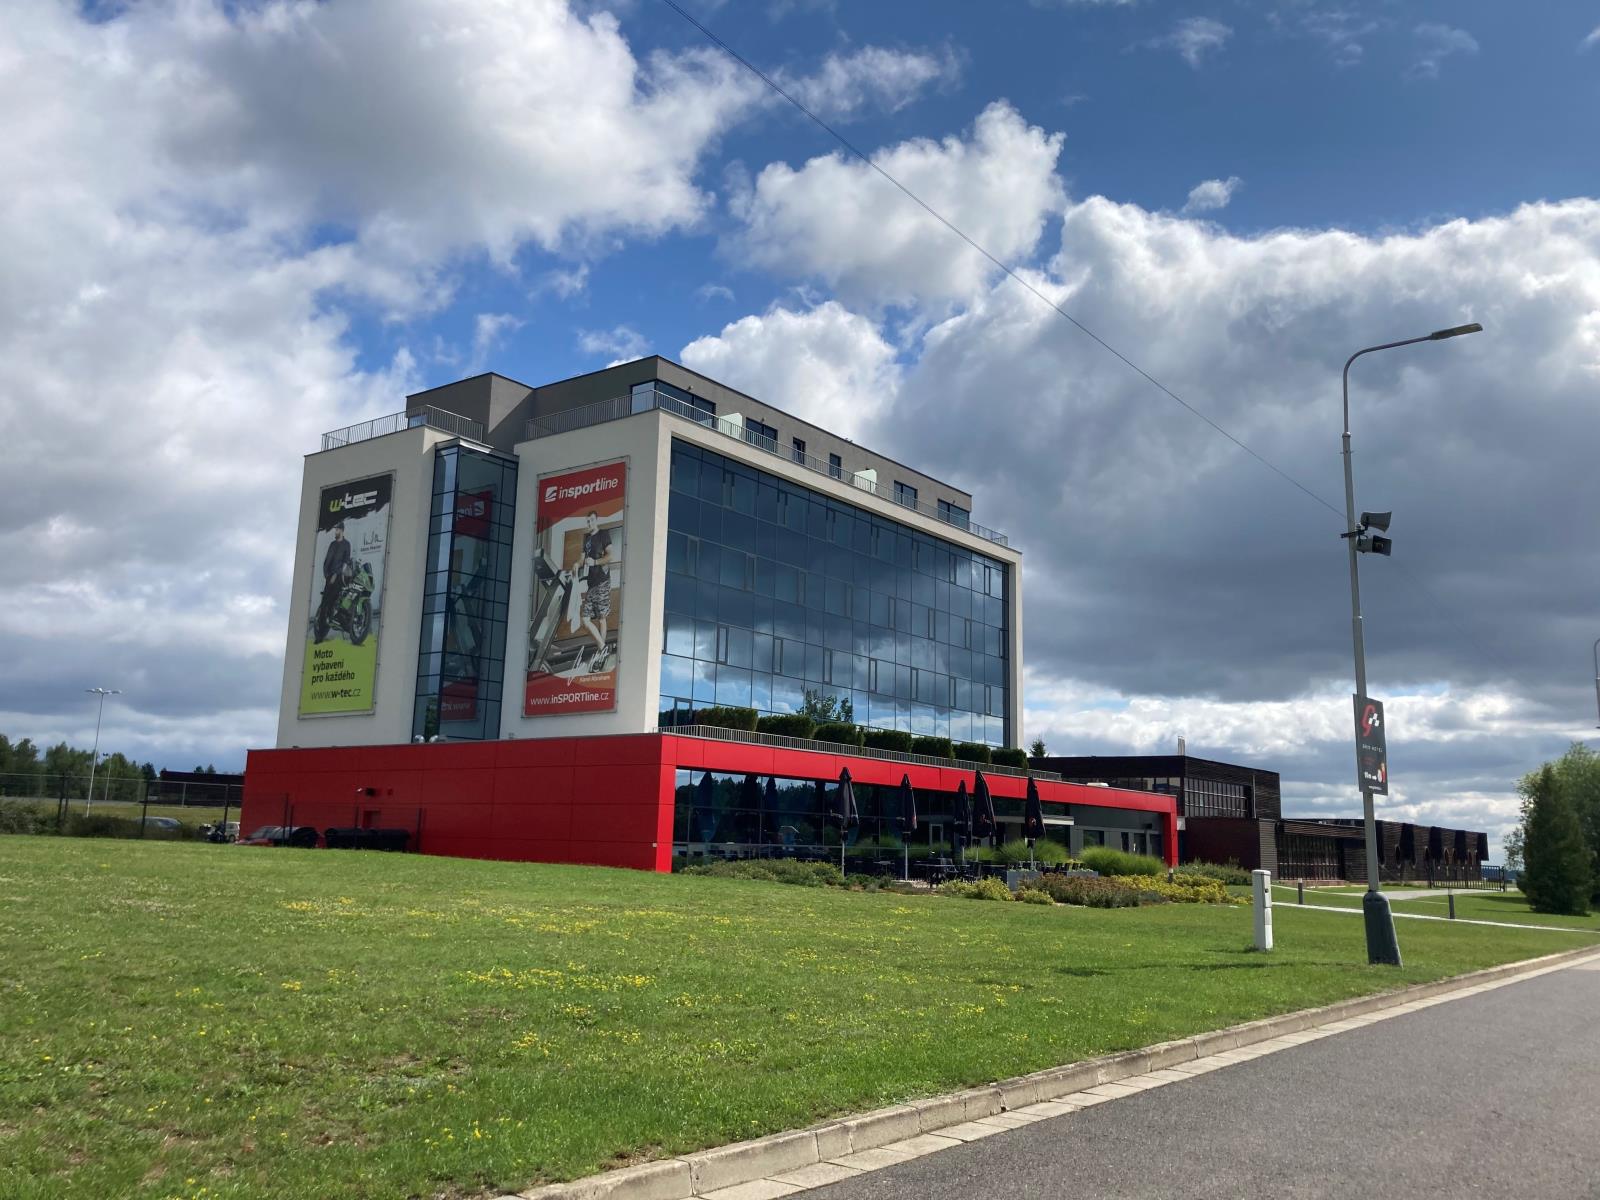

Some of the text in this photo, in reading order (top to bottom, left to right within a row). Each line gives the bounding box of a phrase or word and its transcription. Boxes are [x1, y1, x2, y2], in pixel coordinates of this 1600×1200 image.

[558, 477, 619, 499] insportline
[314, 649, 333, 659] Moto
[313, 659, 344, 672] vybavení
[311, 670, 355, 685] pro každého
[311, 688, 361, 699] www.w-tec.cz
[530, 692, 609, 705] www.inSPORTline.cz
